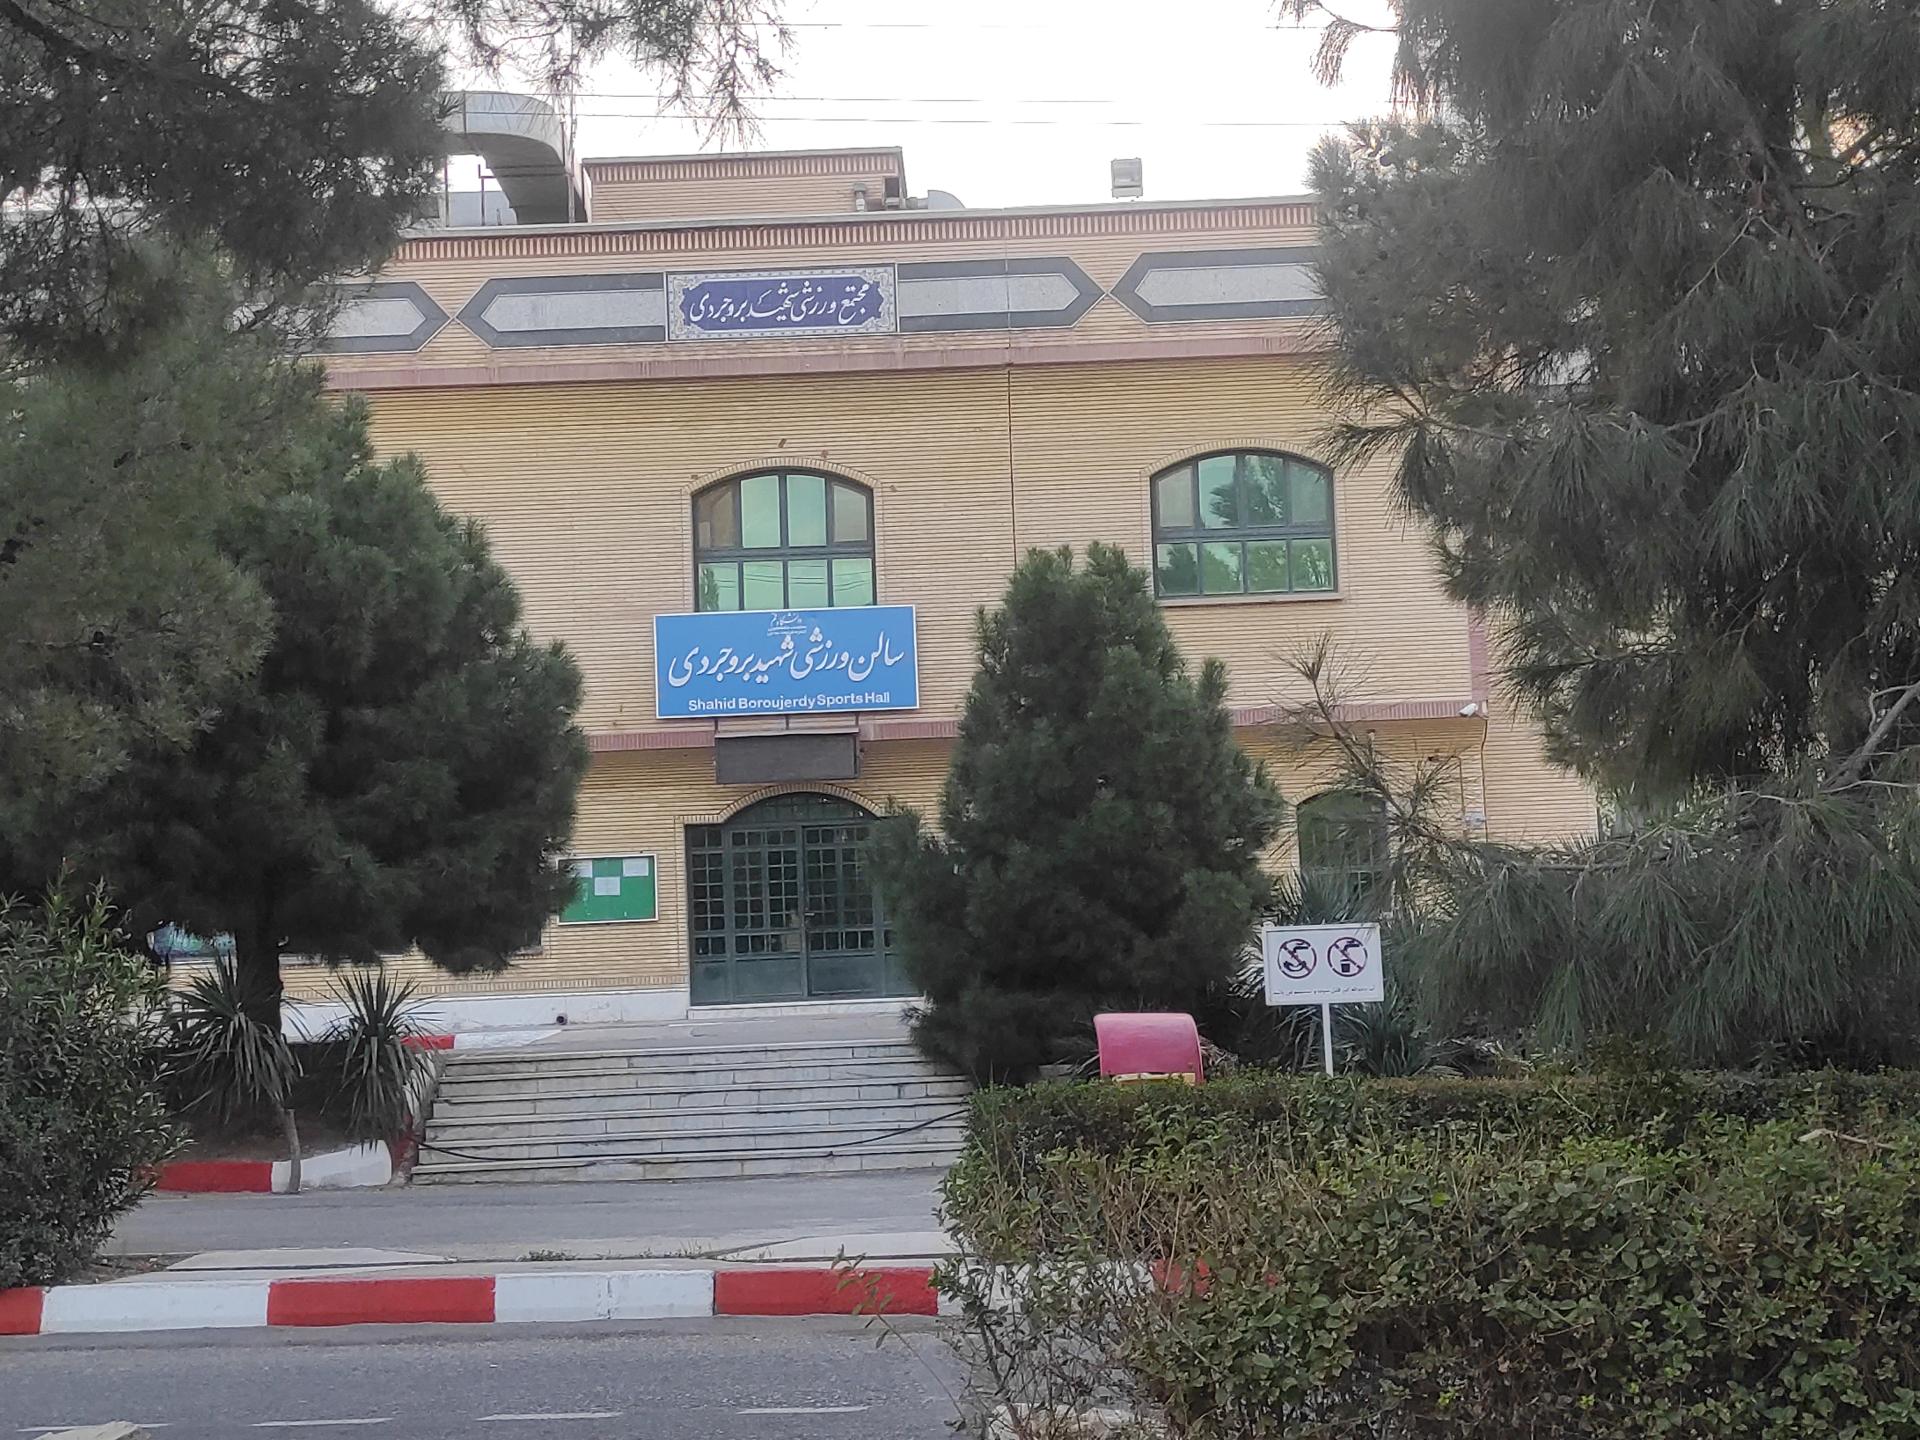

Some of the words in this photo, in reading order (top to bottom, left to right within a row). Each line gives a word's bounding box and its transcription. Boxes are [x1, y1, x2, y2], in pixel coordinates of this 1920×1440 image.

[689, 292, 749, 323] بروجردی
[790, 280, 837, 322] ورزشی
[837, 283, 870, 325] مجتمع
[668, 645, 754, 687] بروجردی
[753, 634, 795, 684] شهید
[788, 626, 849, 680] ورزشی
[847, 631, 905, 682] سالن
[688, 697, 736, 712] Shahid
[738, 693, 816, 710] Boroujerdy
[816, 692, 863, 709] Sports
[864, 691, 890, 704] Hall
